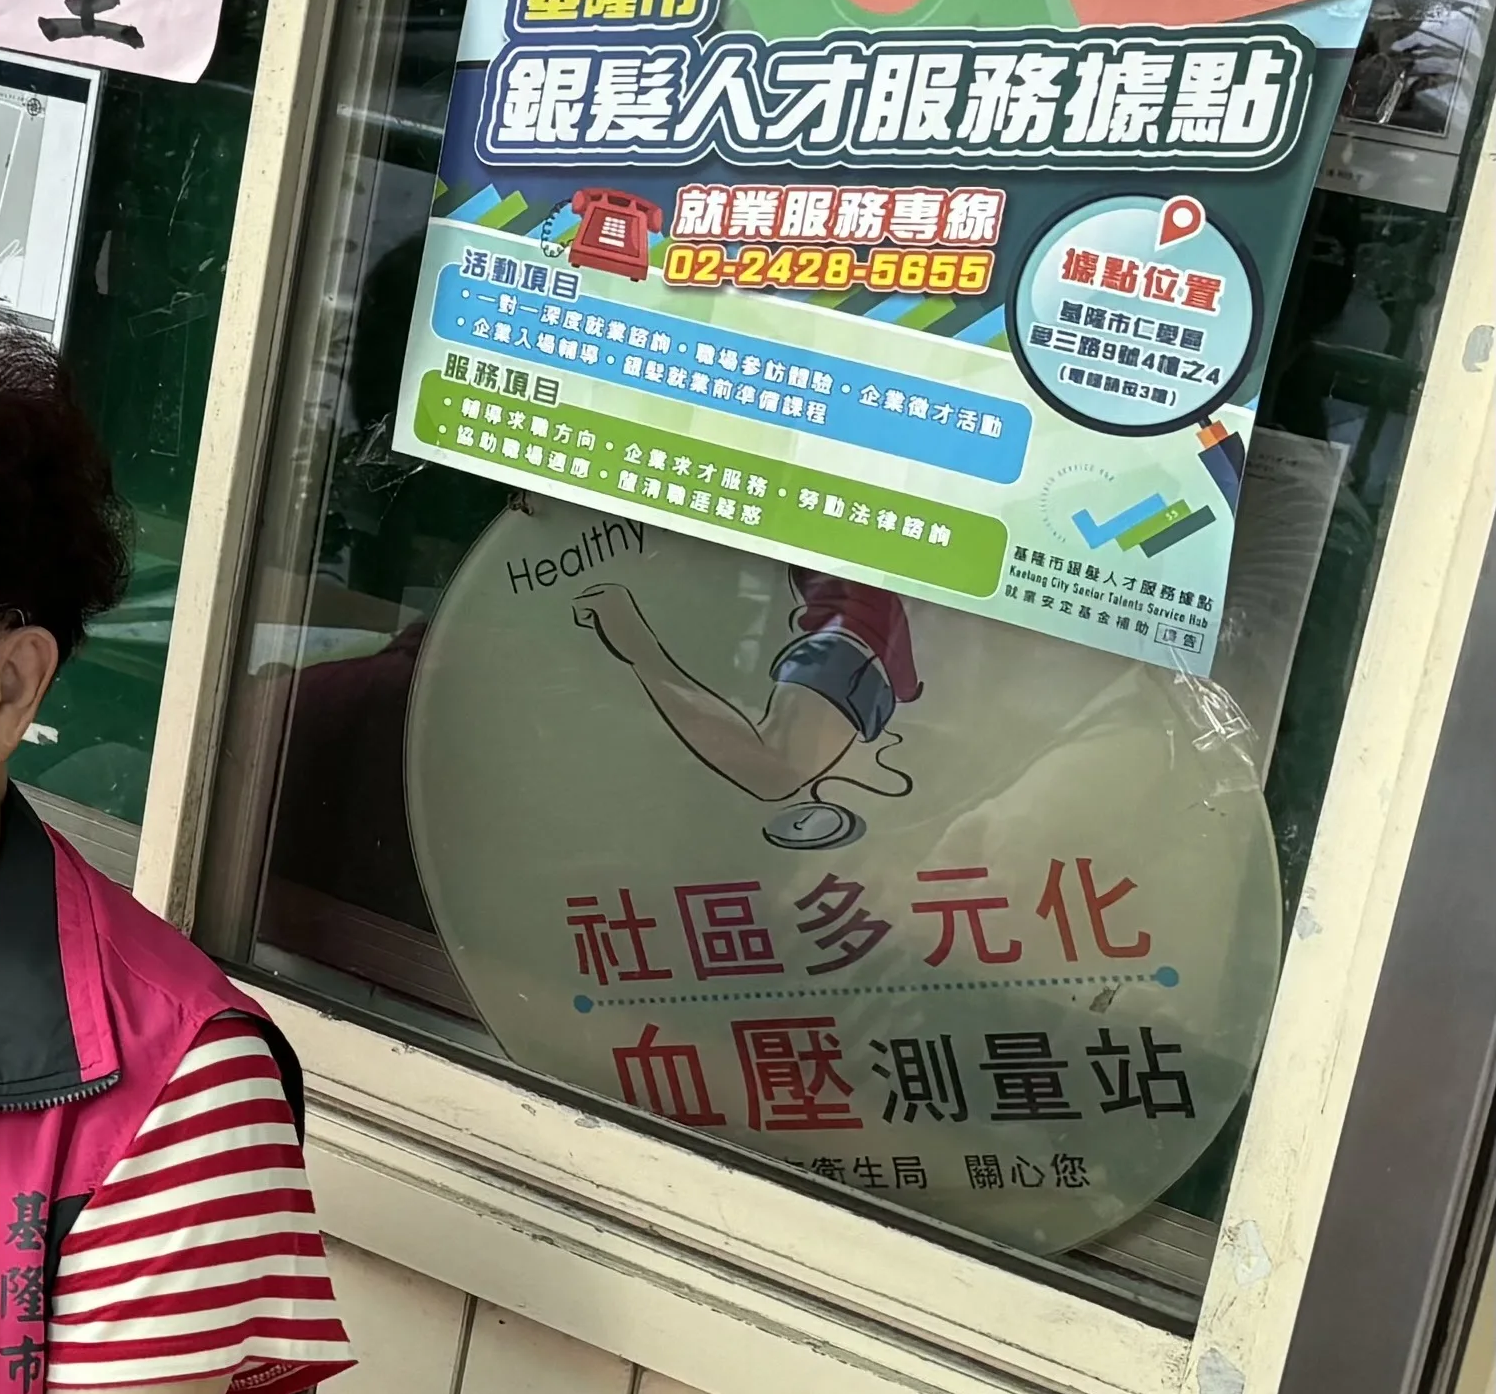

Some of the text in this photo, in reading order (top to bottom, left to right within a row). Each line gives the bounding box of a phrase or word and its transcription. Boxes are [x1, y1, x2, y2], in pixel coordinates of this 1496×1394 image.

[498, 48, 1283, 144] 銀髮人才服務據點
[676, 188, 1004, 244] 就業服務專線
[462, 248, 580, 301] 活動項目
[668, 248, 992, 292] 02-2428-5655
[1062, 247, 1223, 312] 據點位置
[444, 352, 560, 406] 服務項目
[506, 518, 645, 594] Healthy
[1051, 577, 1070, 593] City
[566, 856, 1152, 986] 社區多元化
[611, 1016, 1196, 1133] 血壓測量站
[784, 1152, 1091, 1190] 衛生局 關心您
